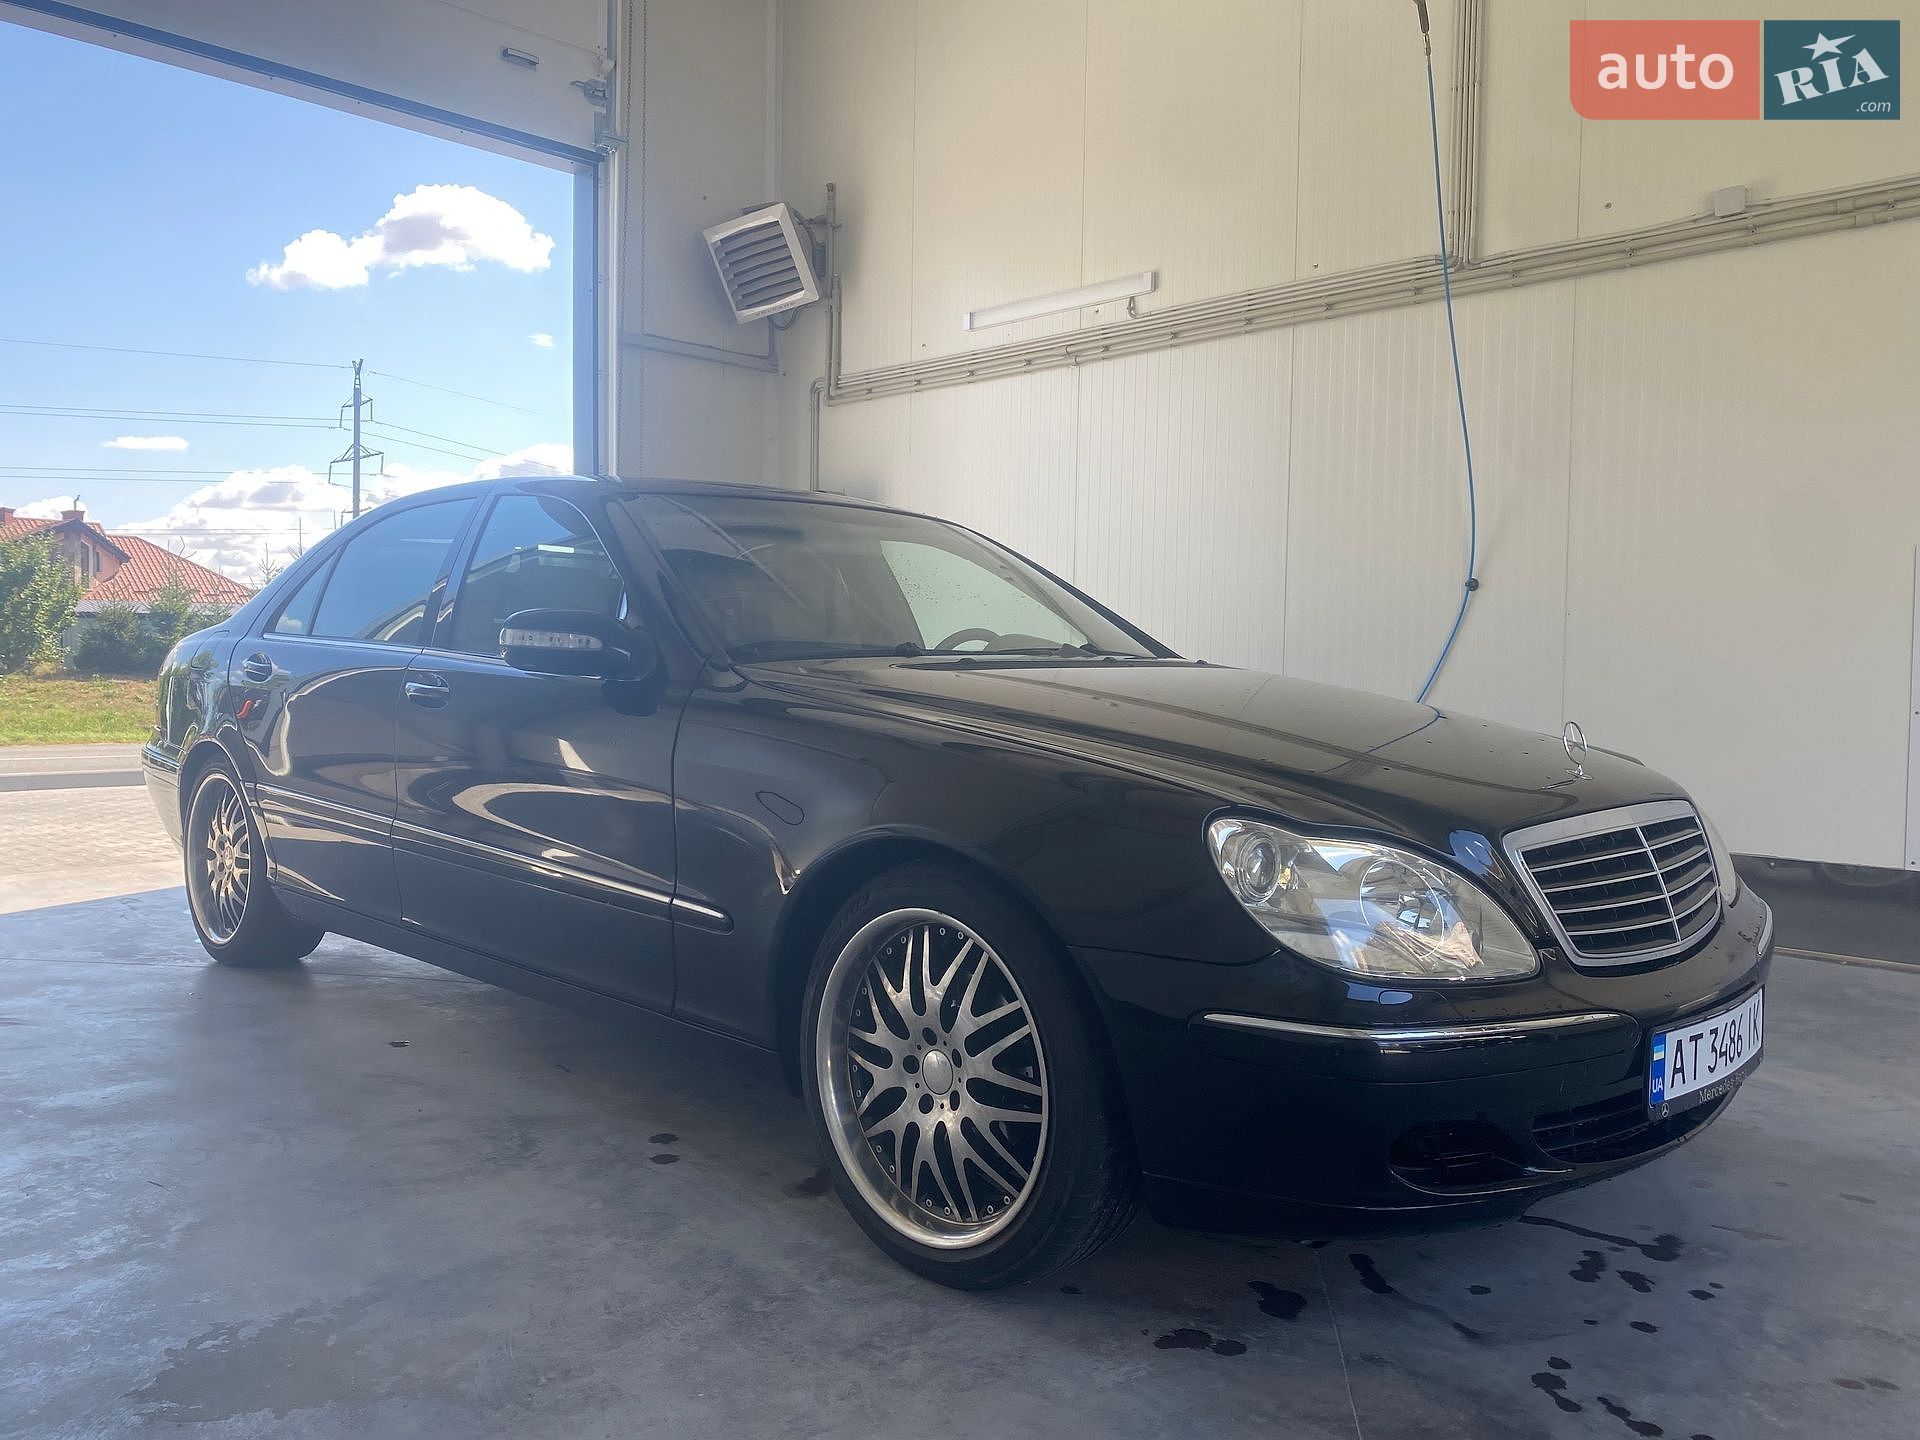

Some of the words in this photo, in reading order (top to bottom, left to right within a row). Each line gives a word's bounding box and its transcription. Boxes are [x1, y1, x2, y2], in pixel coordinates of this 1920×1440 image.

[1670, 1032, 1704, 1089] AT
[1708, 1013, 1744, 1074] 3486
[1747, 999, 1761, 1051] IK
[1652, 1078, 1664, 1093] UA
